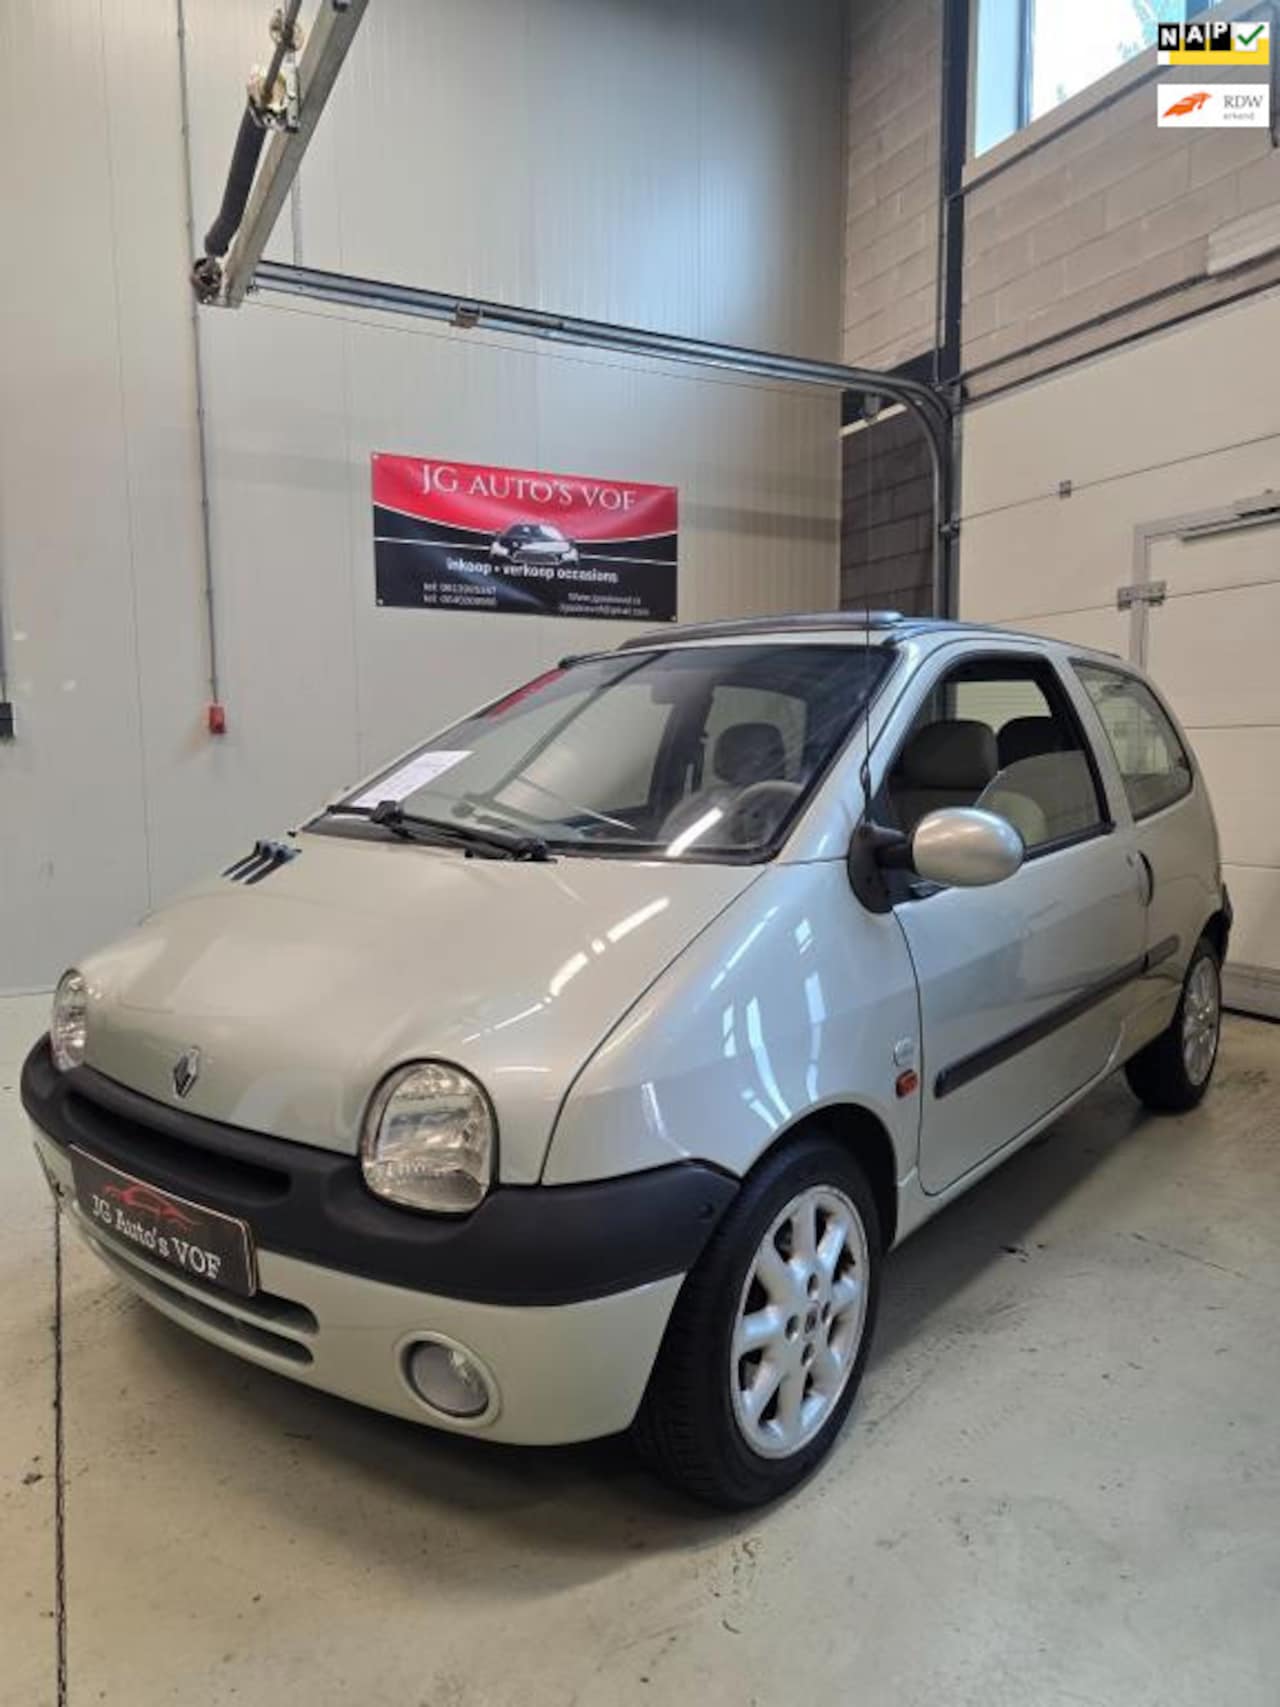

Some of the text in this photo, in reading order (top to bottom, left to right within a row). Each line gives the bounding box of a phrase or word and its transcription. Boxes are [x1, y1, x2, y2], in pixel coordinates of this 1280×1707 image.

[421, 463, 638, 511] JG AUTO'S VOF
[446, 557, 619, 584] inkoop verkoop occasions
[92, 1195, 222, 1279] JG Auto's VOF
